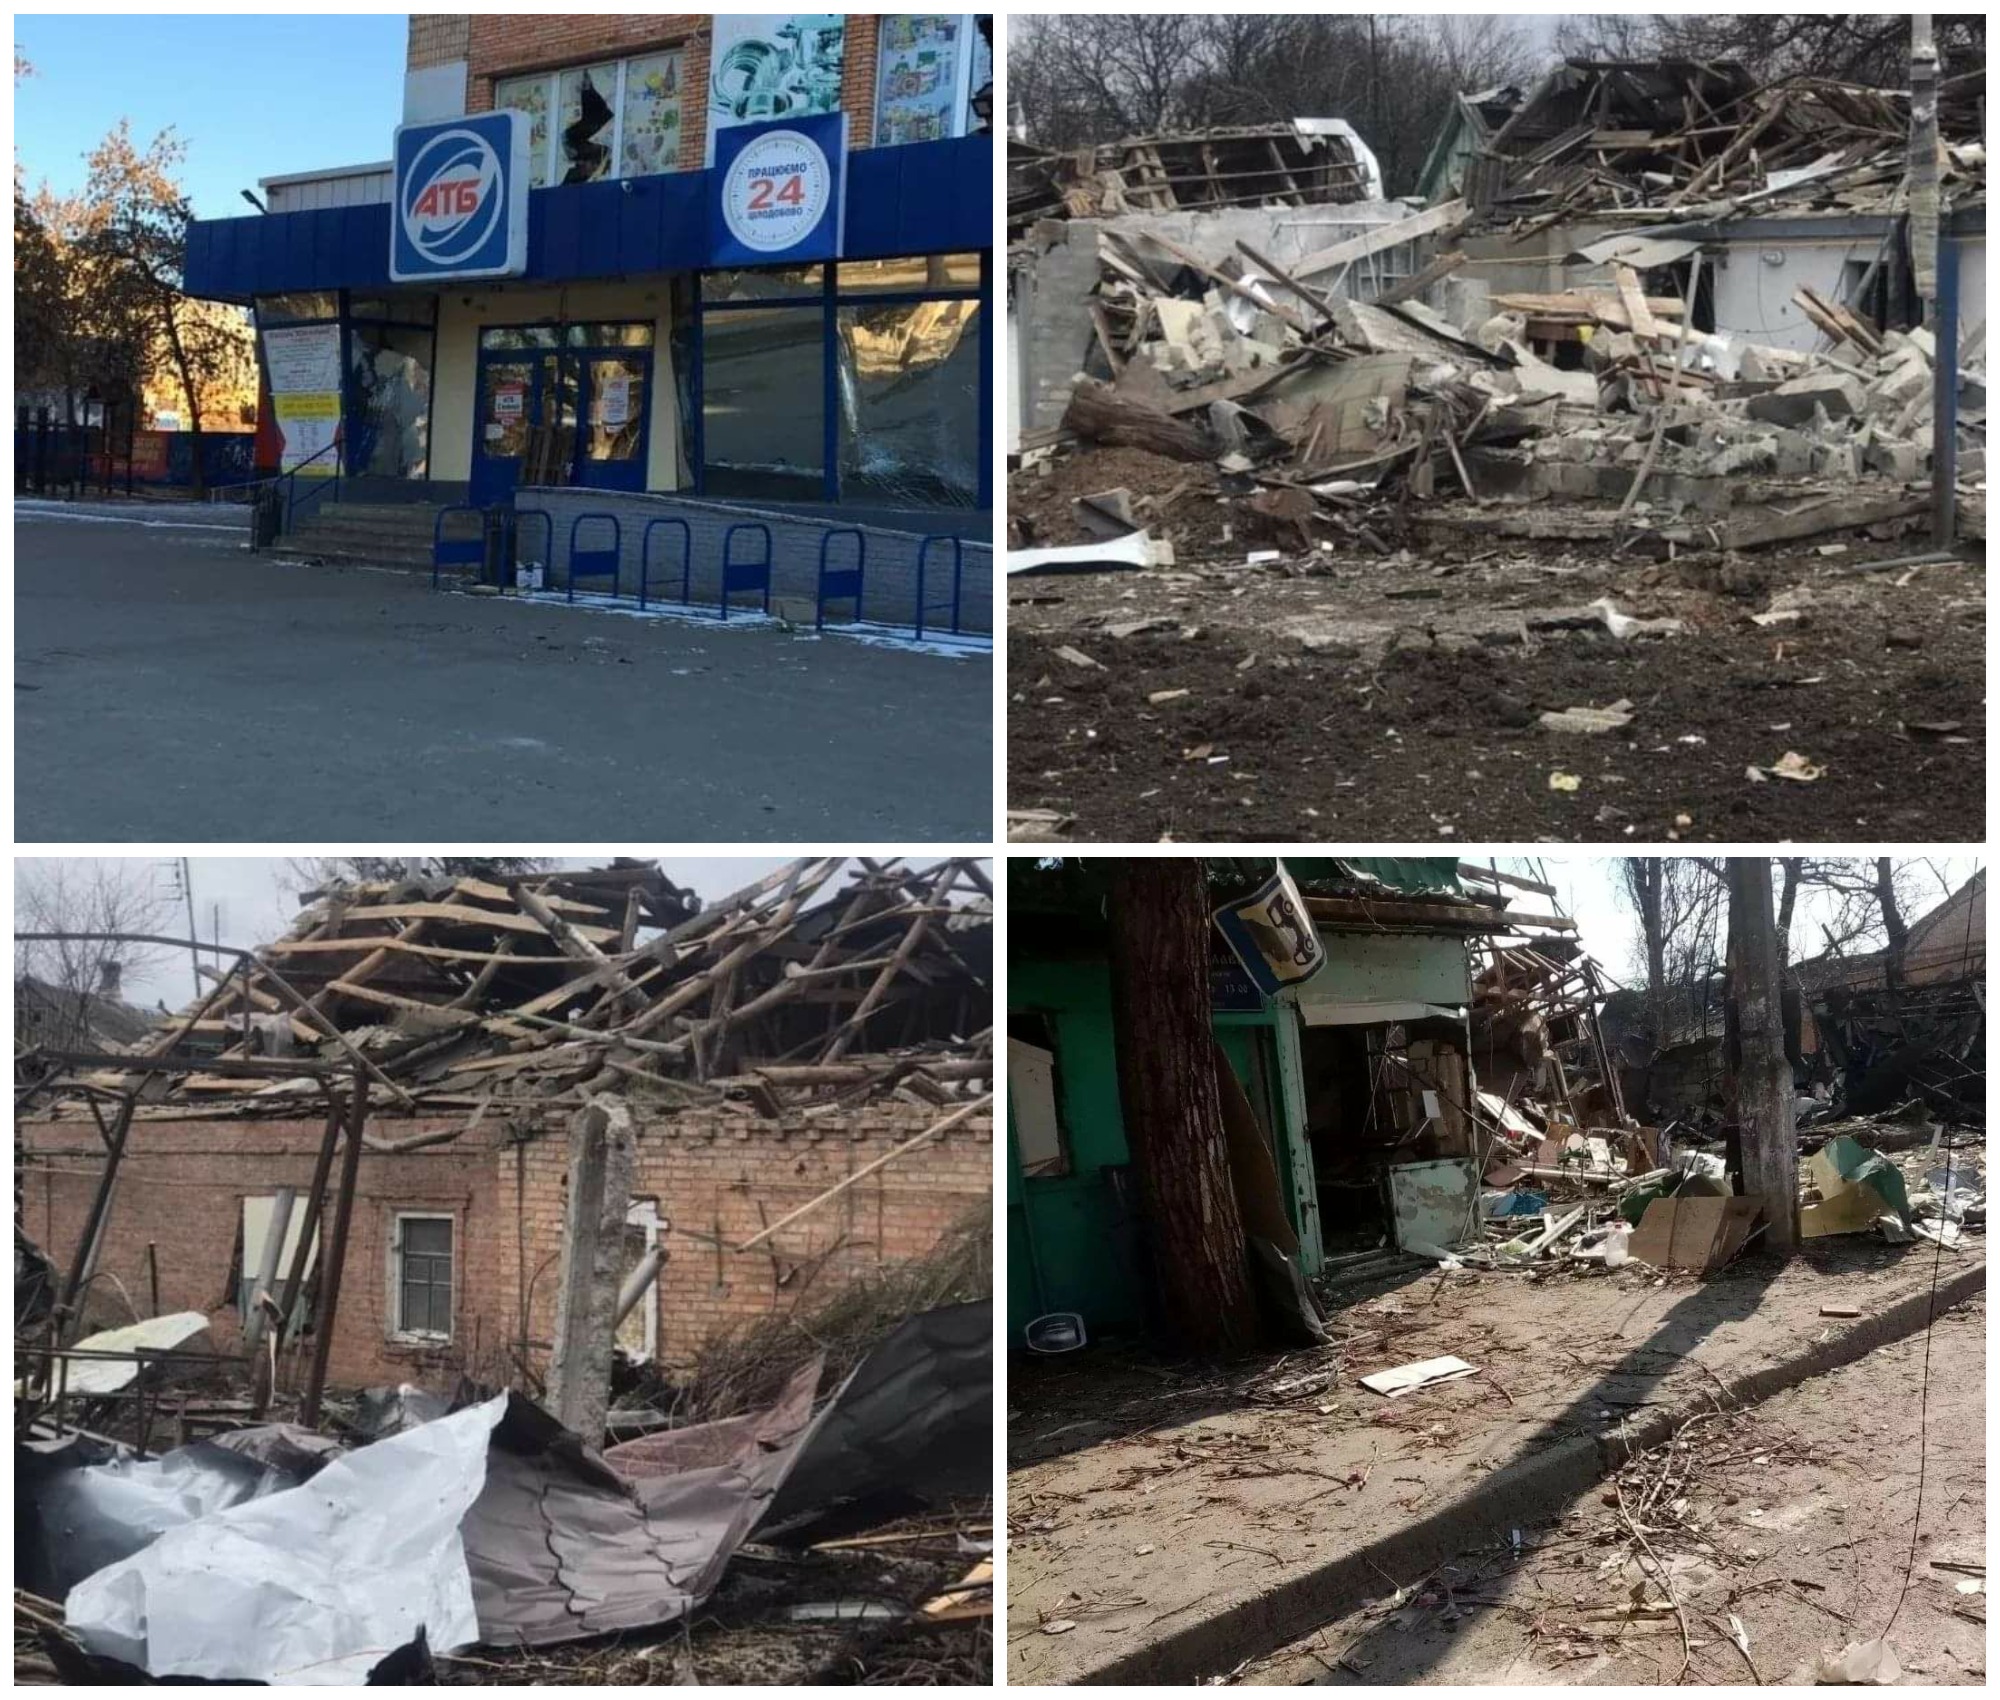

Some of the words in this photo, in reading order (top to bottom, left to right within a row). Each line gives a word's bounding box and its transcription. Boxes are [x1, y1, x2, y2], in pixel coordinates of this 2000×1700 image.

[748, 162, 808, 178] ПРАЦЮЄМО
[414, 178, 482, 217] АТБ
[747, 174, 806, 210] 24
